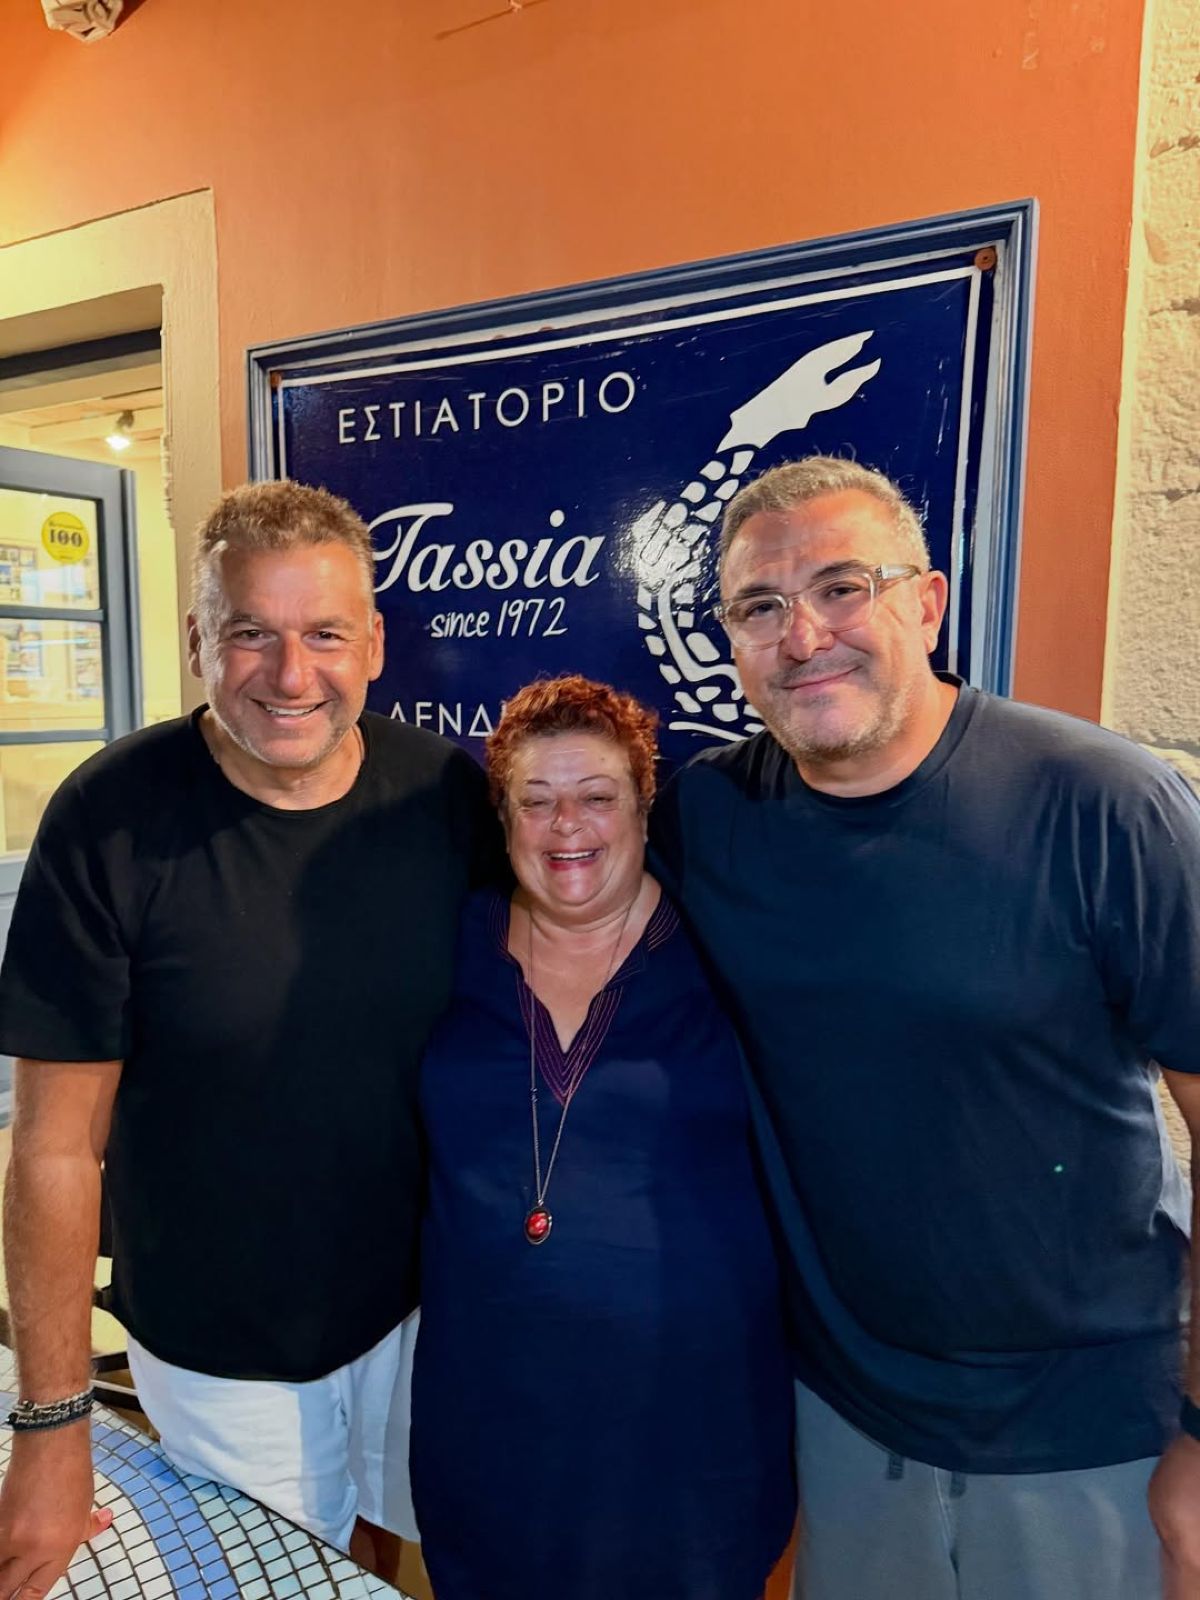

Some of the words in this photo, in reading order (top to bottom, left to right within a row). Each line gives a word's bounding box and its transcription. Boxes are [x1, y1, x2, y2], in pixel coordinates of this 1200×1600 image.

[338, 371, 636, 444] ΕΣΤΙΑΤΟΡΙΟ
[49, 528, 83, 548] 100
[367, 501, 606, 594] Tassia
[430, 610, 490, 638] since
[496, 596, 569, 638] 1972
